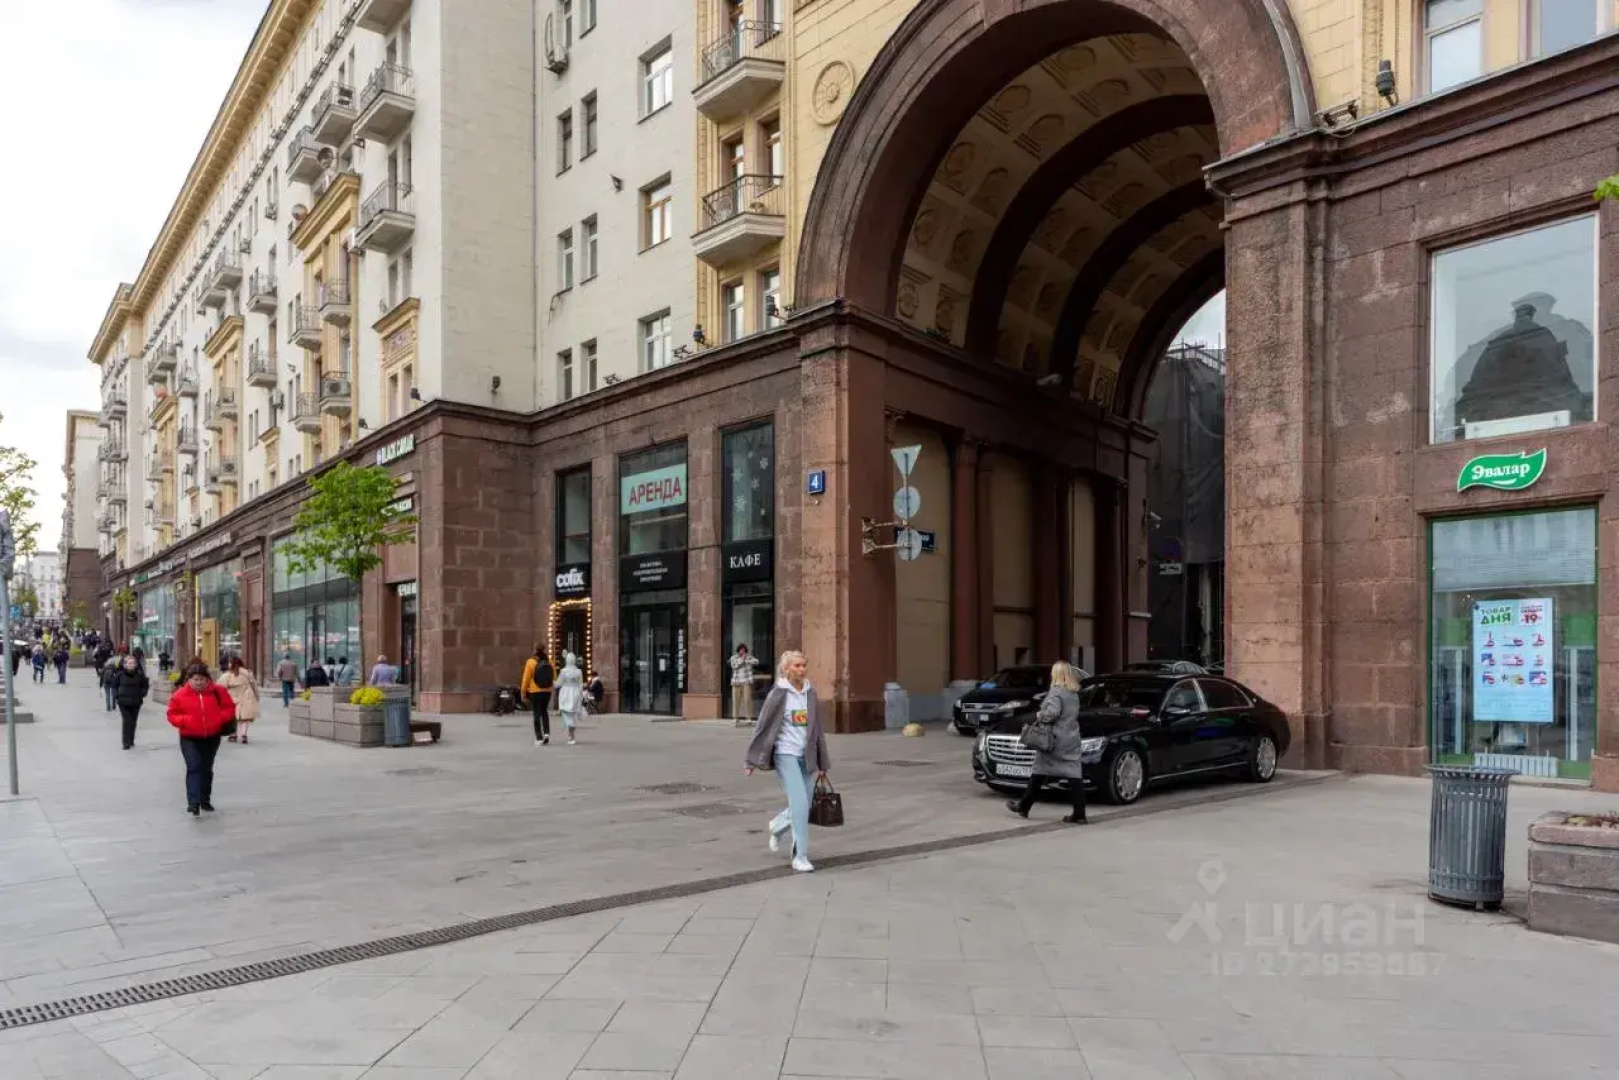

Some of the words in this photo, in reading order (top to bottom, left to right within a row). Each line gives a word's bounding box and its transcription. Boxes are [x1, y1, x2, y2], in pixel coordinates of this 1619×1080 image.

[1471, 463, 1531, 479] Эвалар
[811, 474, 819, 489] 4
[628, 476, 682, 506] АРЕНДА
[729, 553, 761, 569] КАФЕ
[556, 568, 584, 588] cofix
[1481, 613, 1511, 624] ДНЯ
